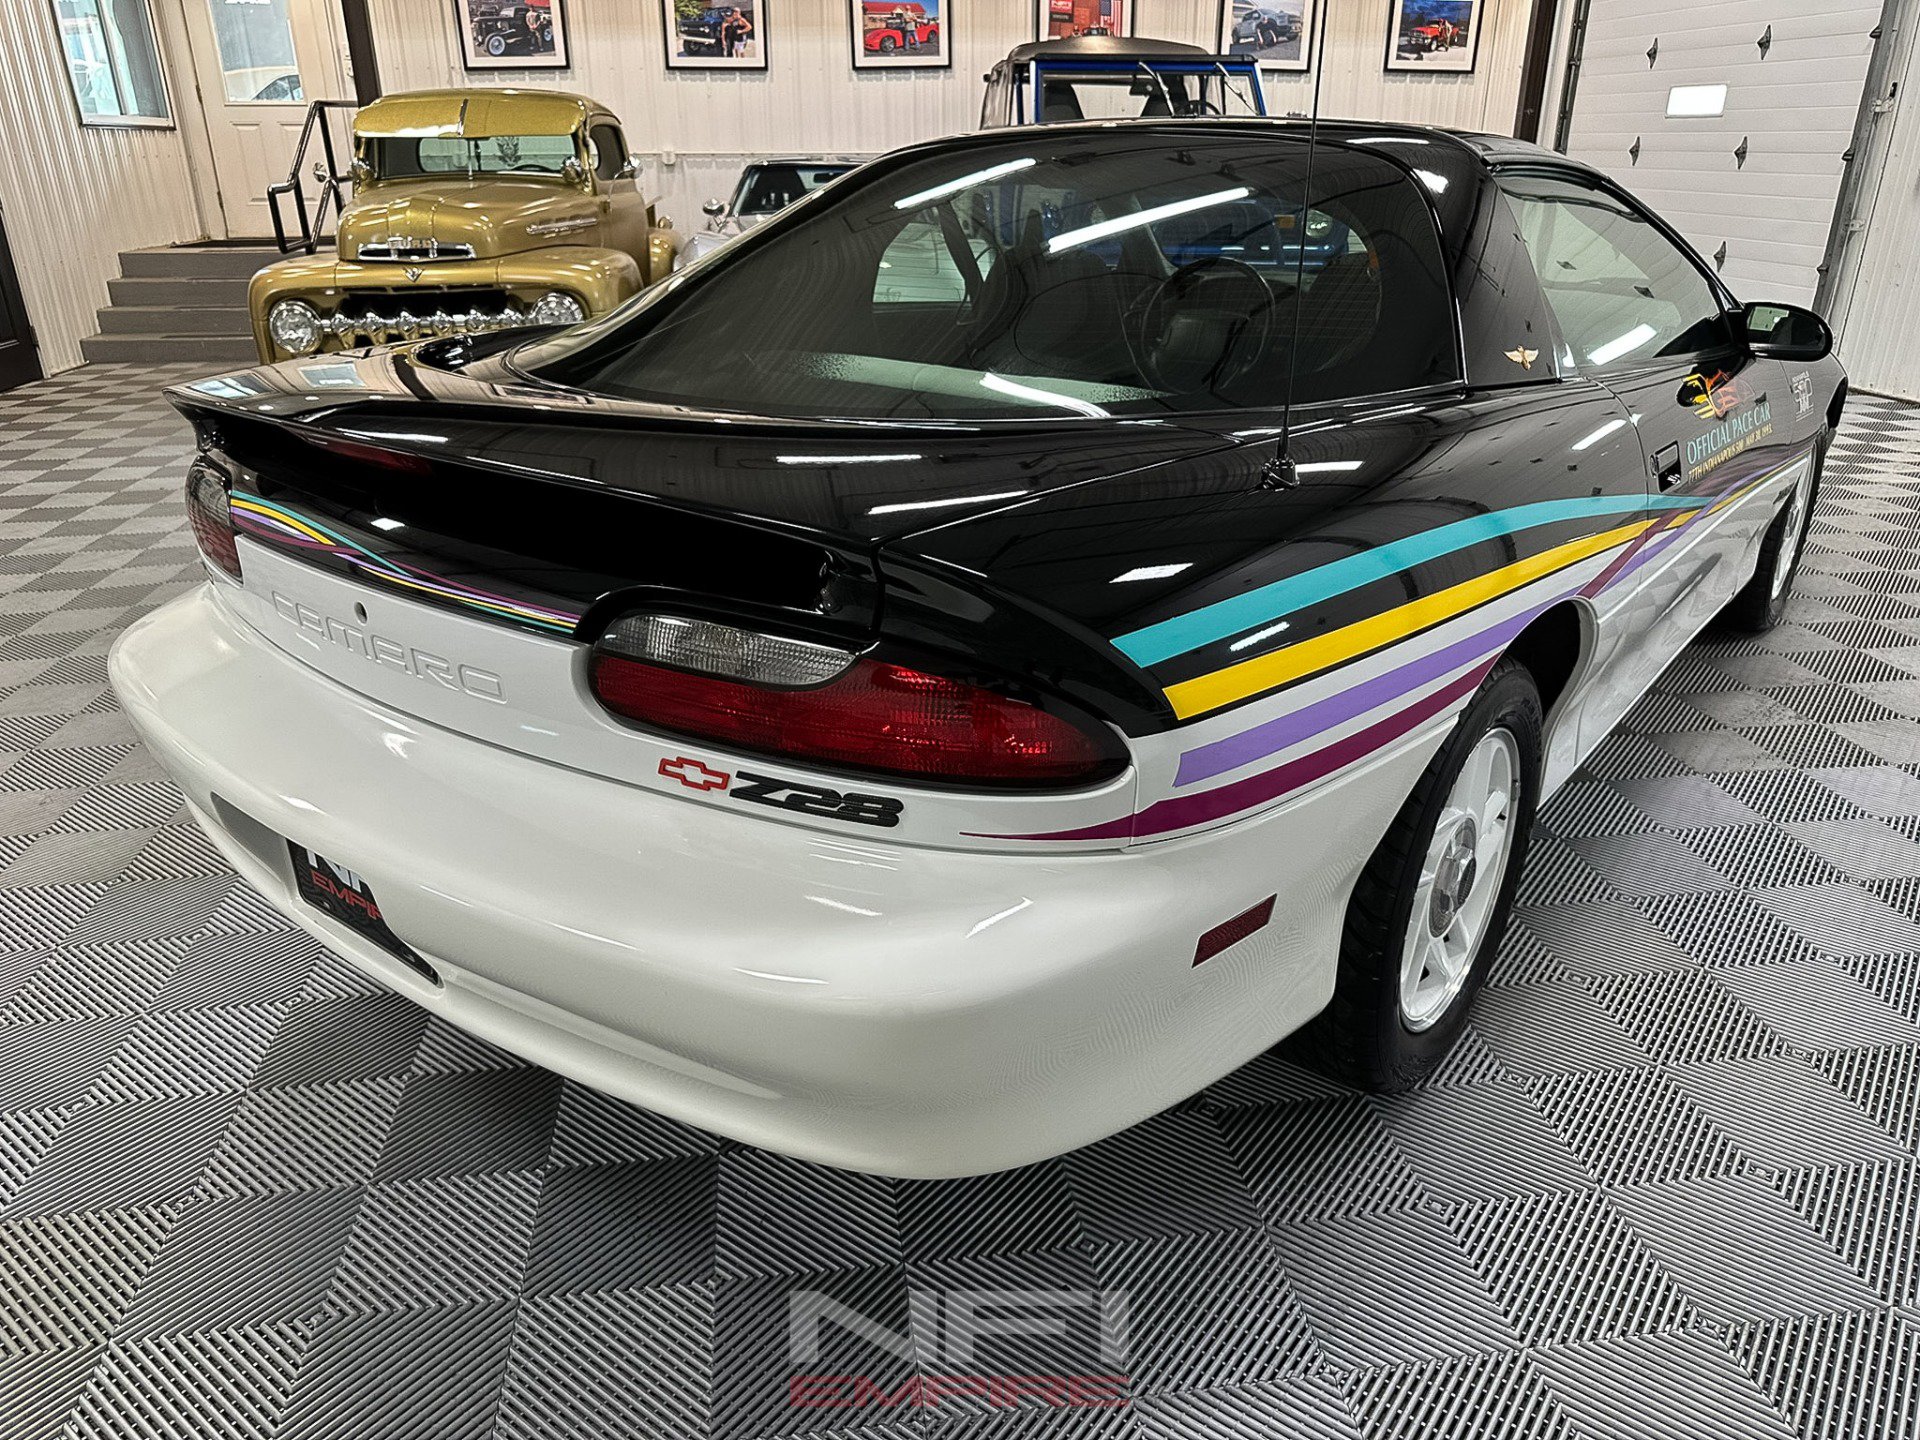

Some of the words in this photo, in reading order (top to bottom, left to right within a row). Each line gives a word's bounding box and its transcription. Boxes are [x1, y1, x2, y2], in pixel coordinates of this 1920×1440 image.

[1687, 422, 1731, 465] OFFICIAL
[1732, 410, 1753, 439] PACE
[1753, 402, 1771, 426] CAR
[271, 590, 508, 704] CAMARO
[729, 770, 904, 827] Z28
